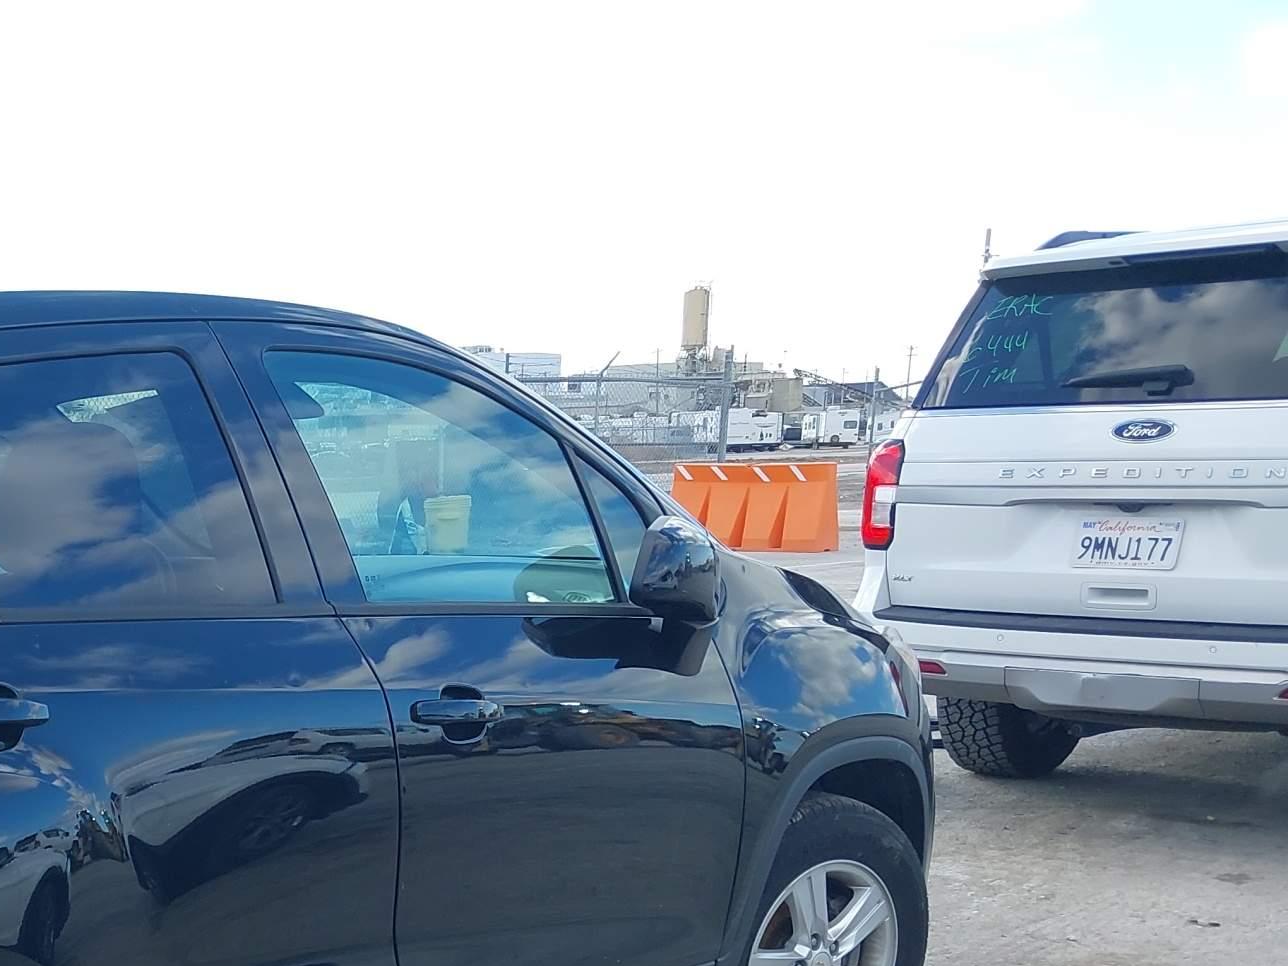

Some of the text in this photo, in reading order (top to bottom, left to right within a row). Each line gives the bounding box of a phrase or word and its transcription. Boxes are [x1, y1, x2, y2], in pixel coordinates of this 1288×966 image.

[1122, 422, 1162, 438] Ford
[998, 466, 1287, 480] EXPEDITION
[1077, 536, 1174, 562] 9MNJ177
